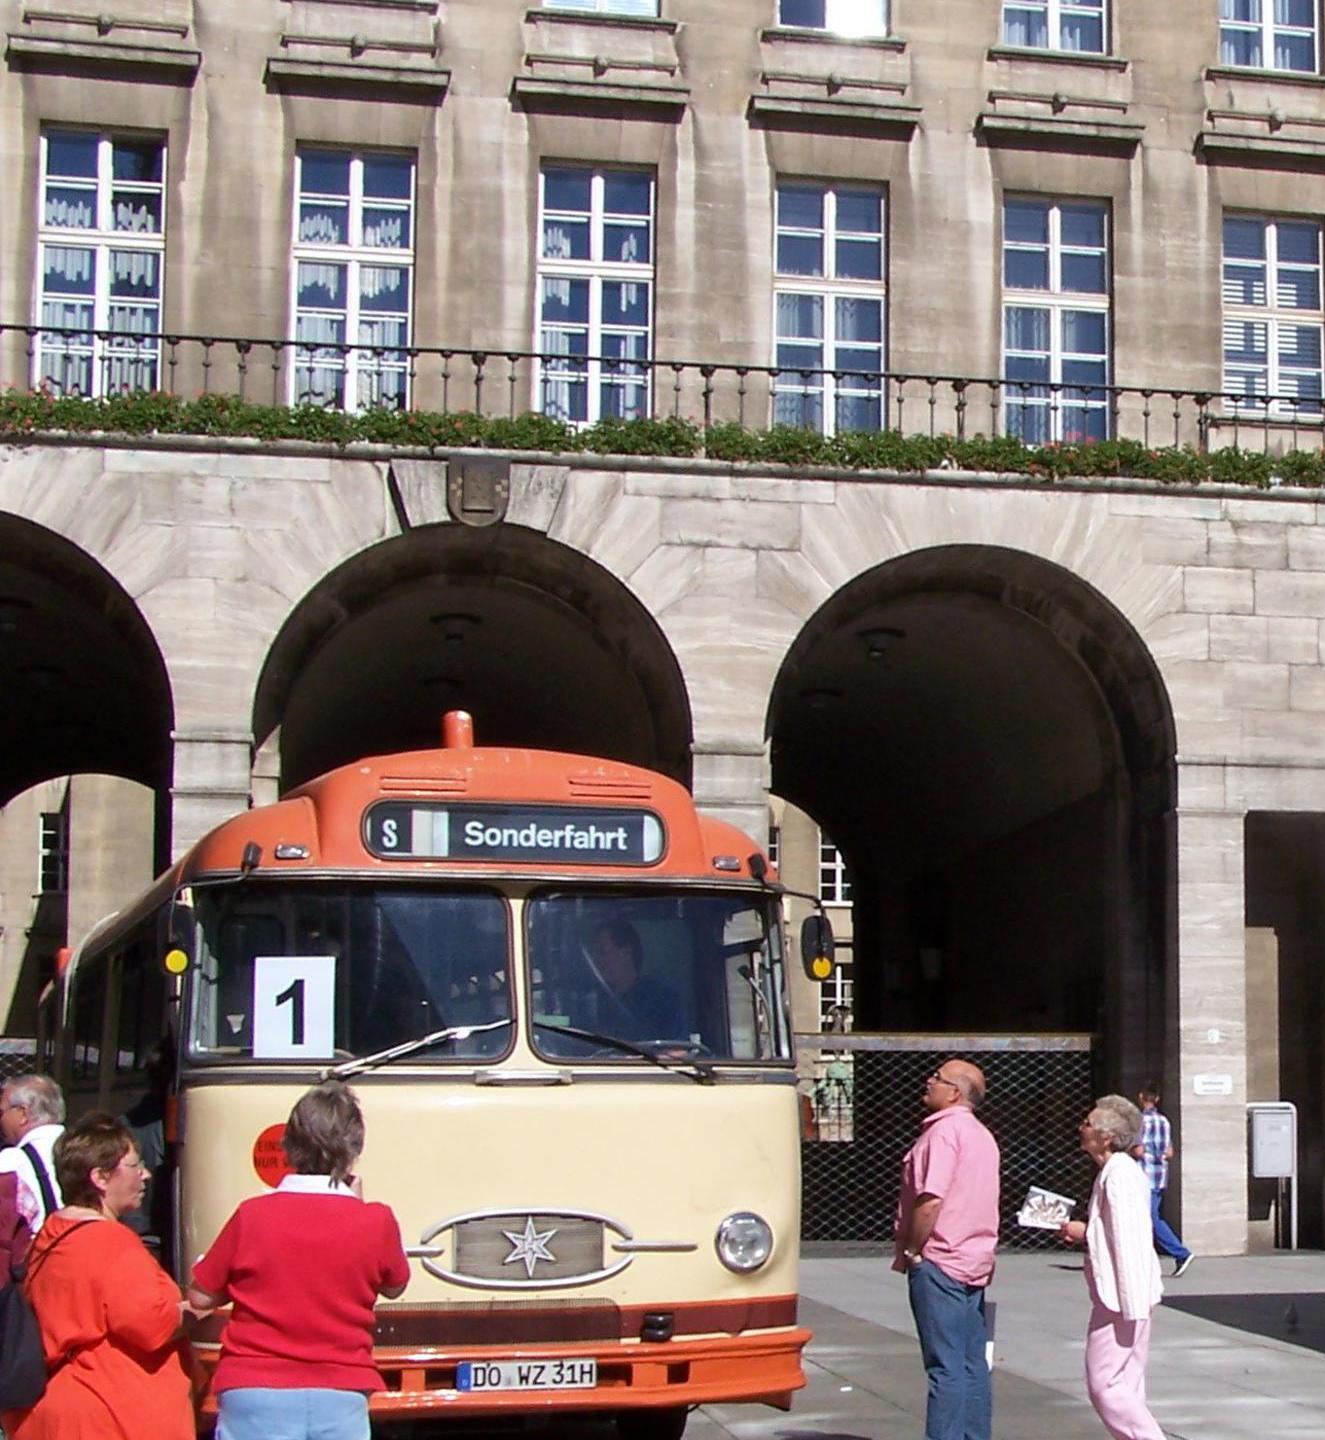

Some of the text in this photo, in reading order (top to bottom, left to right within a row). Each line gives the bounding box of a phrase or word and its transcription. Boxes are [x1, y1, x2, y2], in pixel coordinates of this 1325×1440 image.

[381, 818, 399, 848] S
[463, 820, 628, 850] Sonderfahrt
[275, 978, 305, 1046] 1
[472, 1363, 594, 1387] DO WZ 31H
